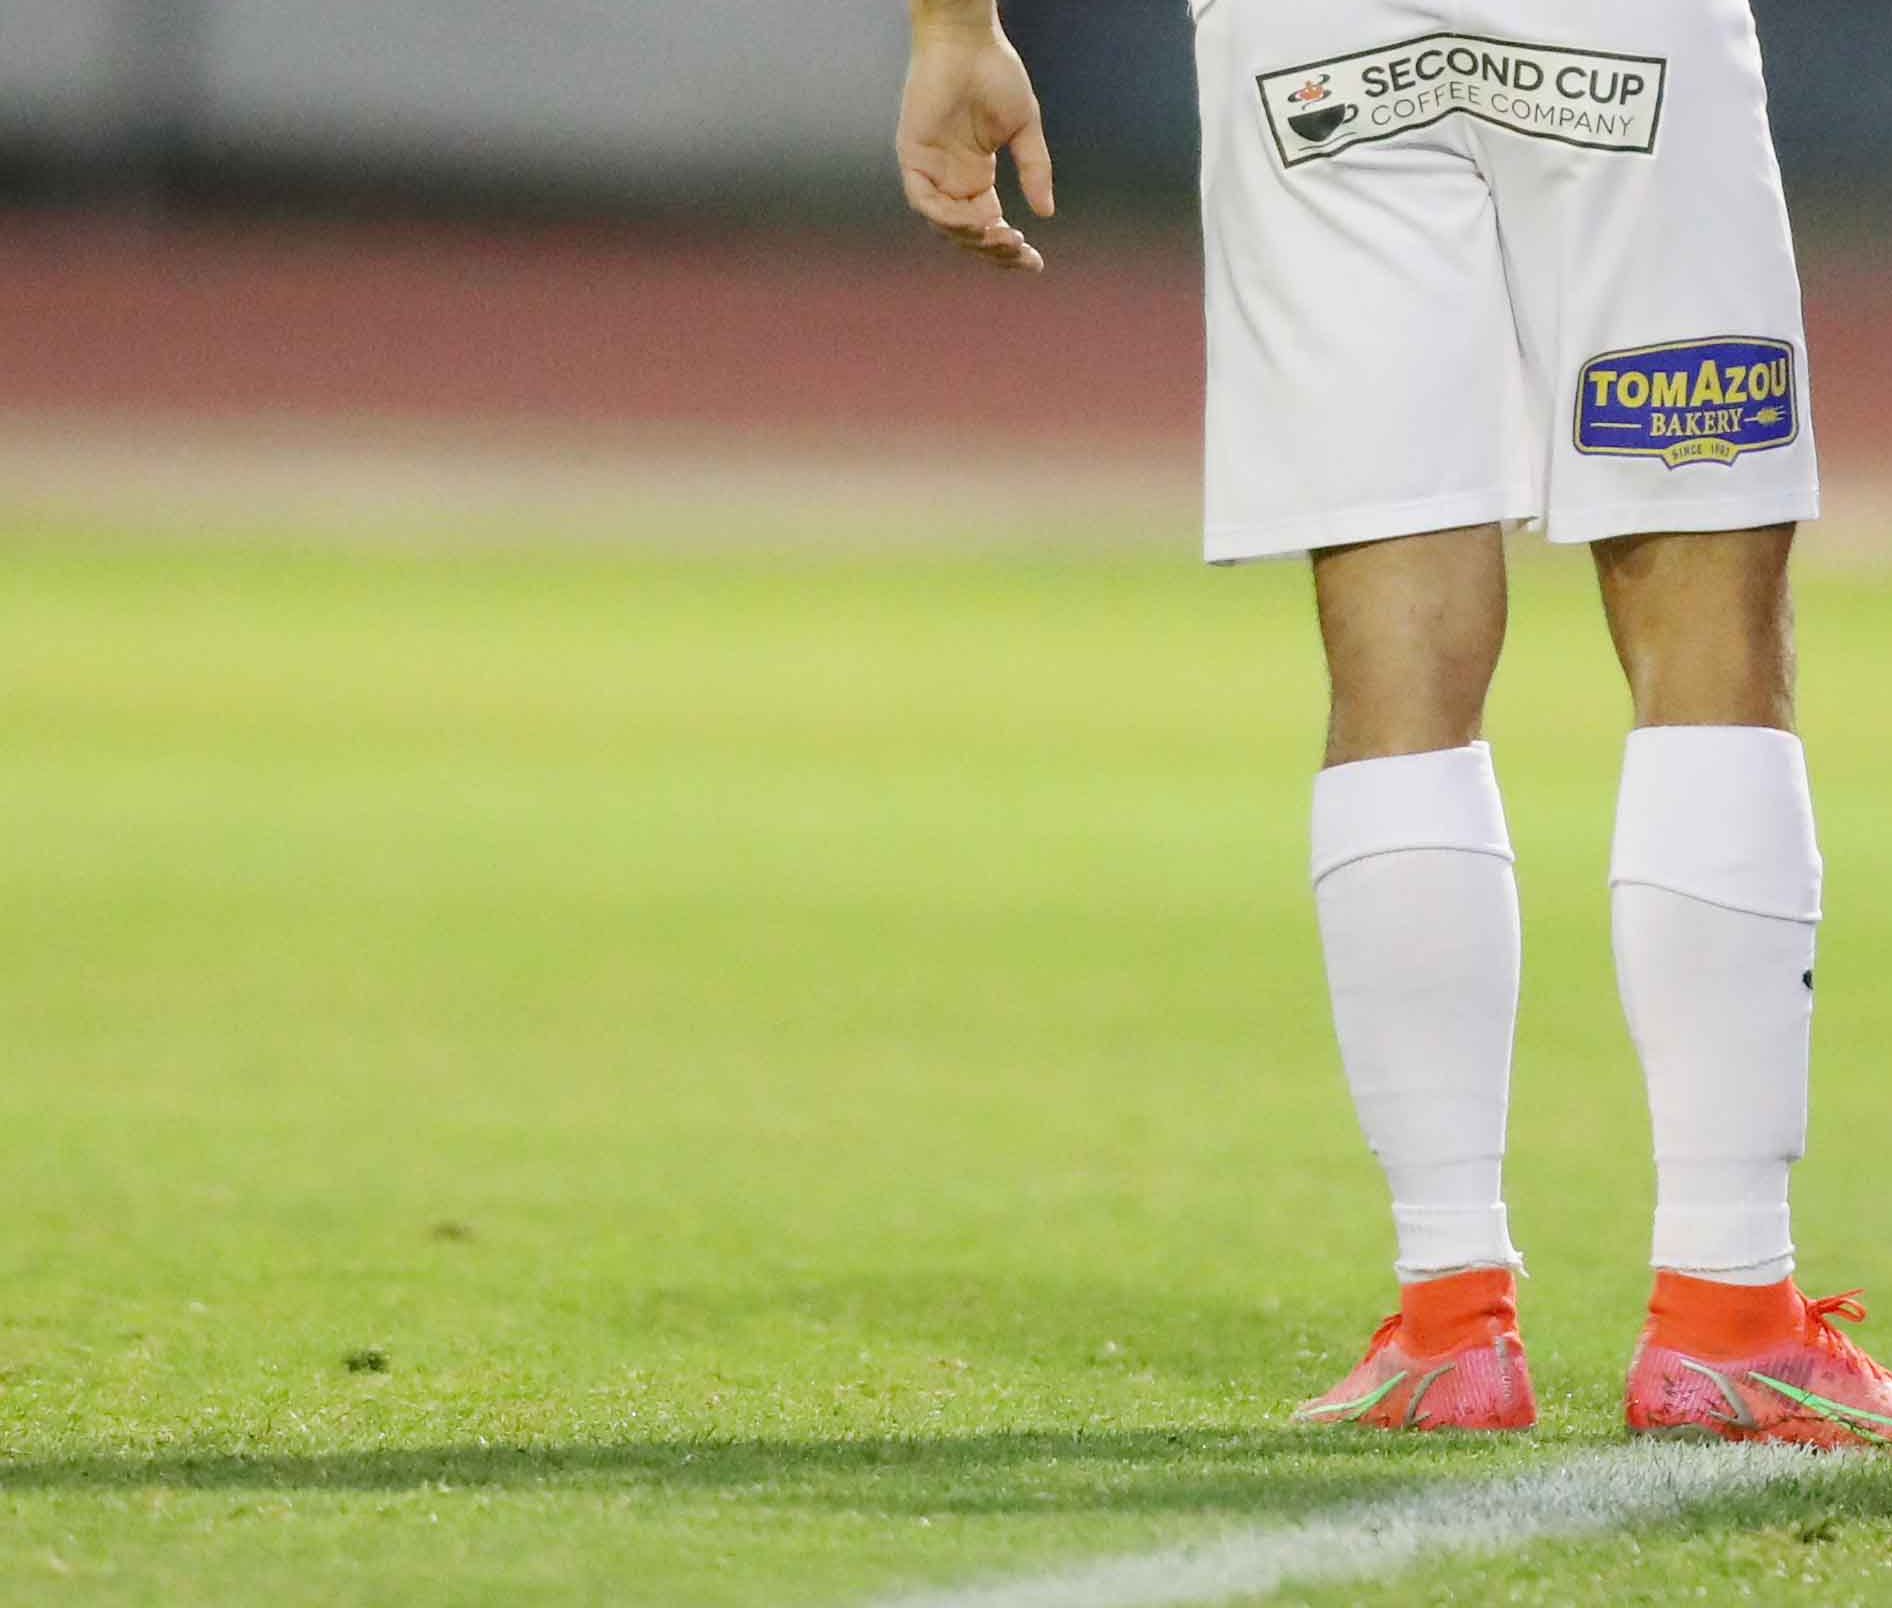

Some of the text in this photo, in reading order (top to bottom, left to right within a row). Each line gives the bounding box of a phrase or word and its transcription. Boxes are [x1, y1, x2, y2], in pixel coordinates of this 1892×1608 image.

[1361, 47, 1644, 106] SECOND CUP
[1370, 81, 1635, 137] COFFEE COMPANY
[1590, 359, 1786, 408] TOMAZOU
[1650, 408, 1744, 437] BAKERY
